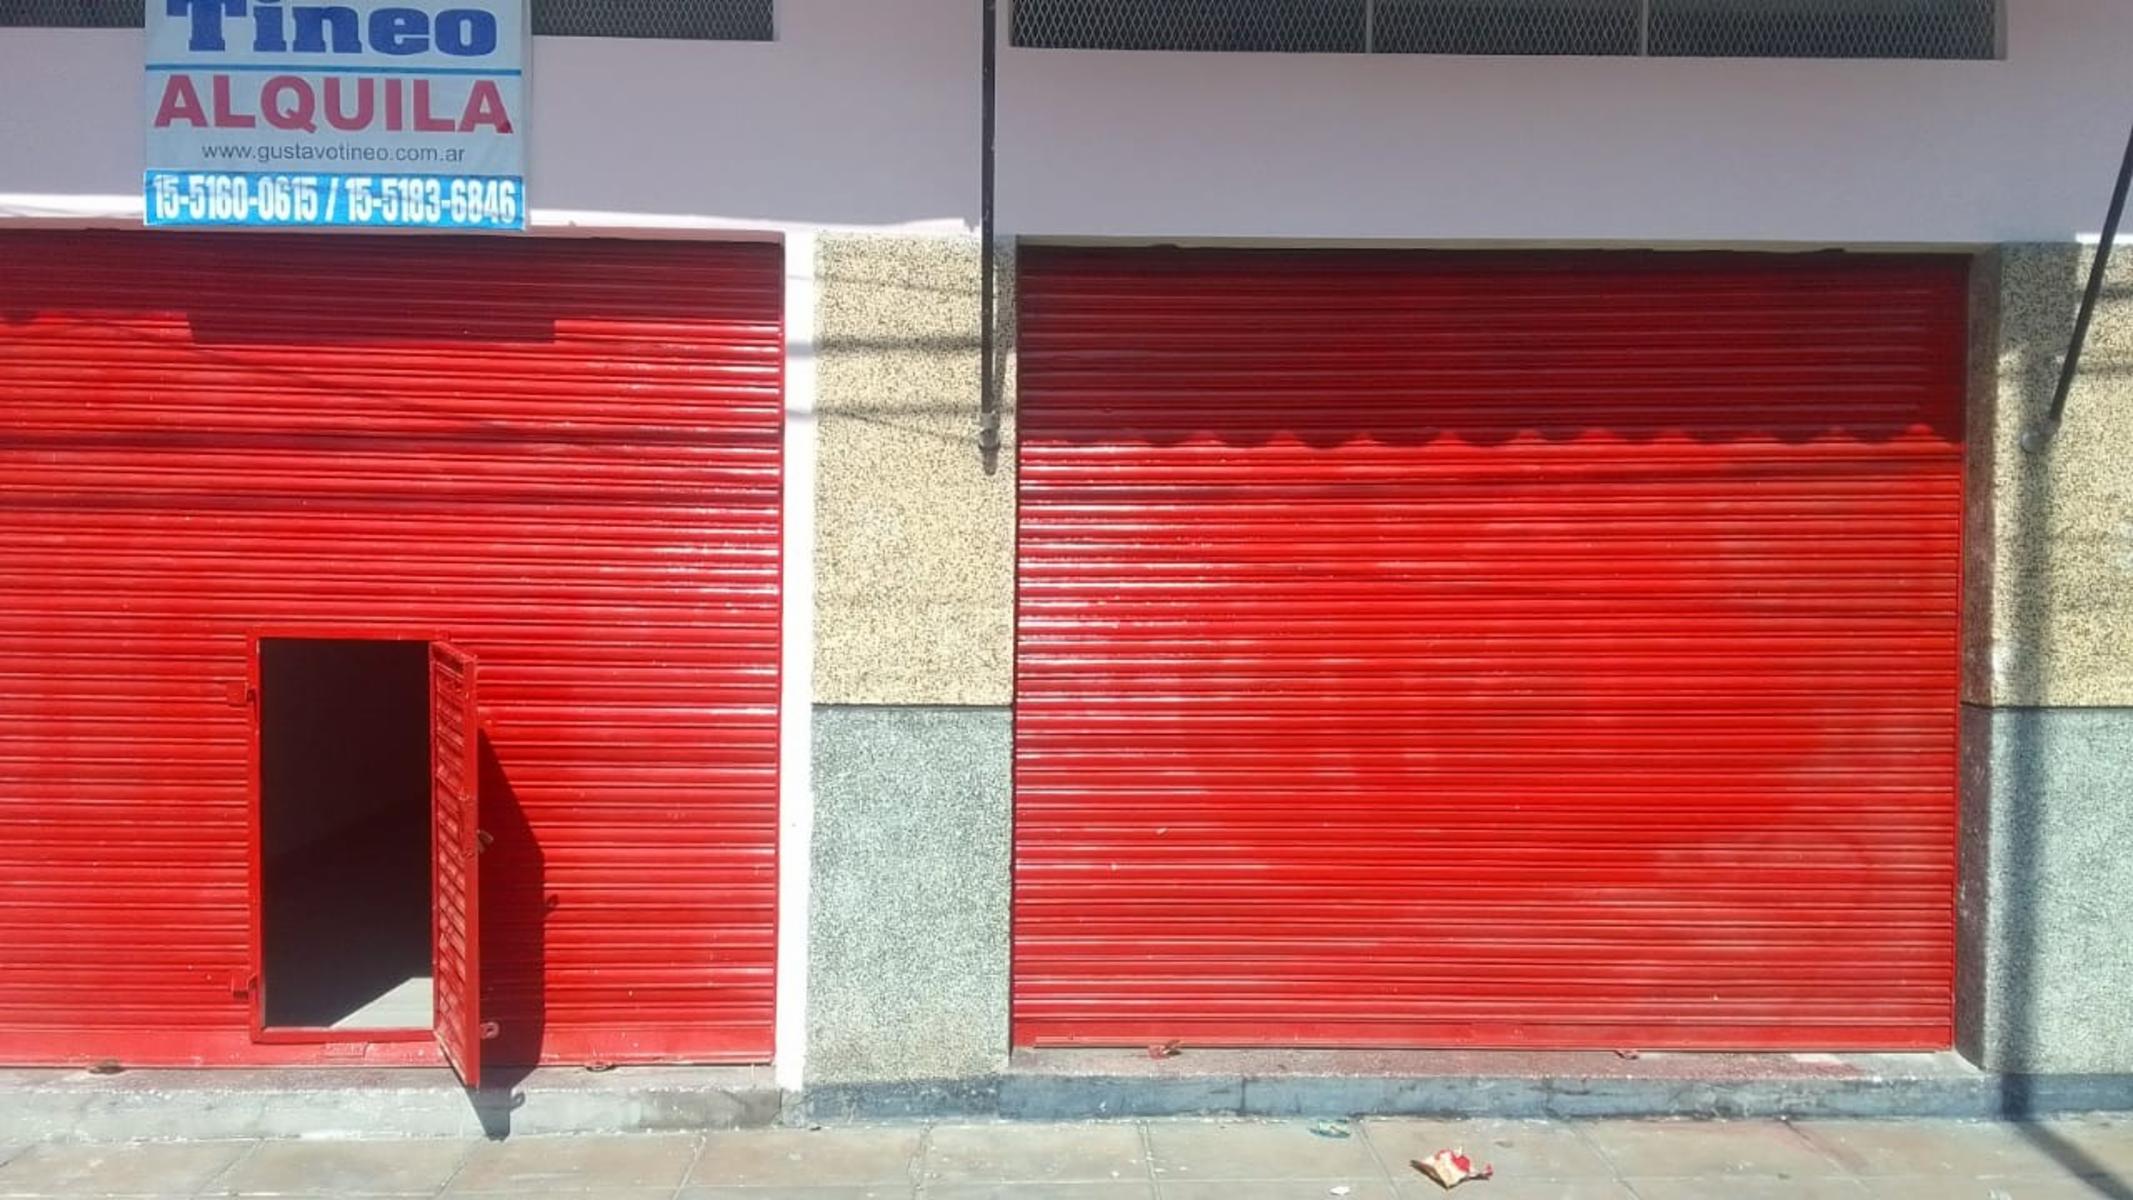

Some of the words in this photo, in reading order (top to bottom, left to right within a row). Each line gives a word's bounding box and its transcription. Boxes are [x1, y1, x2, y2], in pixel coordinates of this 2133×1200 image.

[167, 0, 497, 56] Tineo
[154, 74, 514, 134] ALQUILA
[201, 143, 465, 163] www.gustavotineo.com.ar
[153, 174, 318, 222] 15-5160-0615
[325, 179, 338, 222] /
[345, 178, 516, 225] 15-5183-6846
